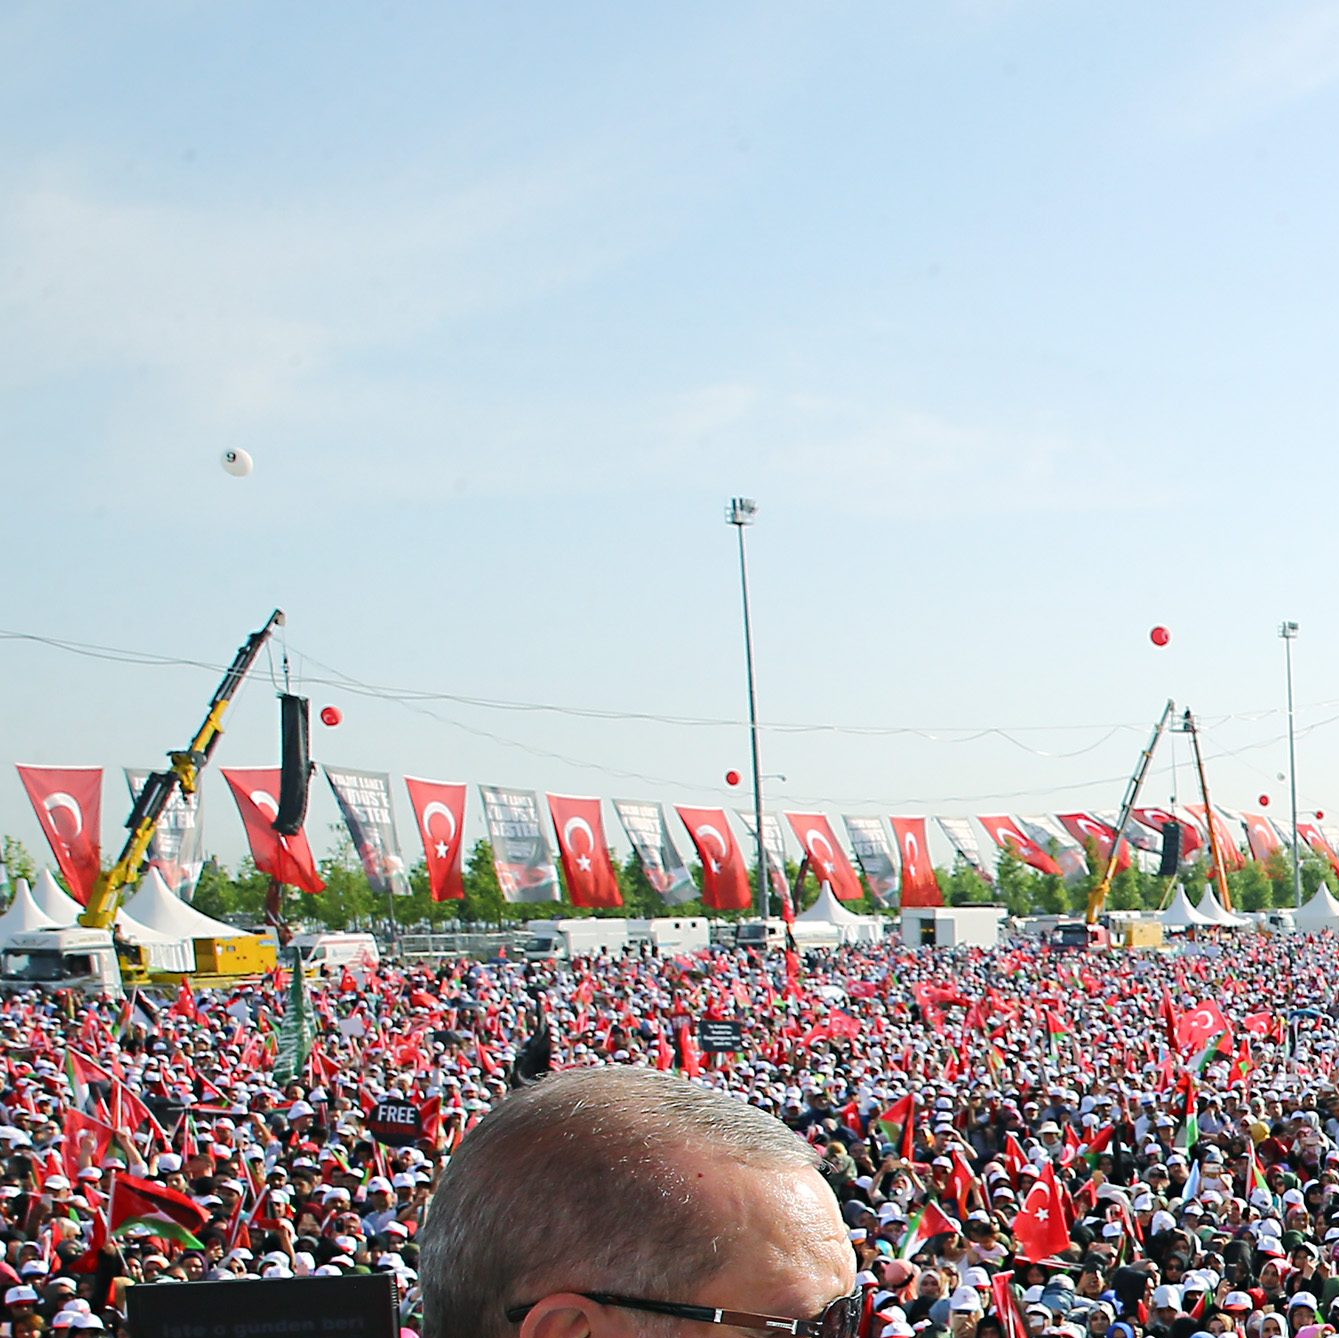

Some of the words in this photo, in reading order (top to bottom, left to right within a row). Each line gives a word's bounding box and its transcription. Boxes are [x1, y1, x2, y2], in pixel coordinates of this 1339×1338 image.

[378, 1105, 416, 1124] FREE
[213, 1326, 226, 1336] o
[234, 1319, 315, 1338] günden
[322, 1315, 364, 1331] beri
